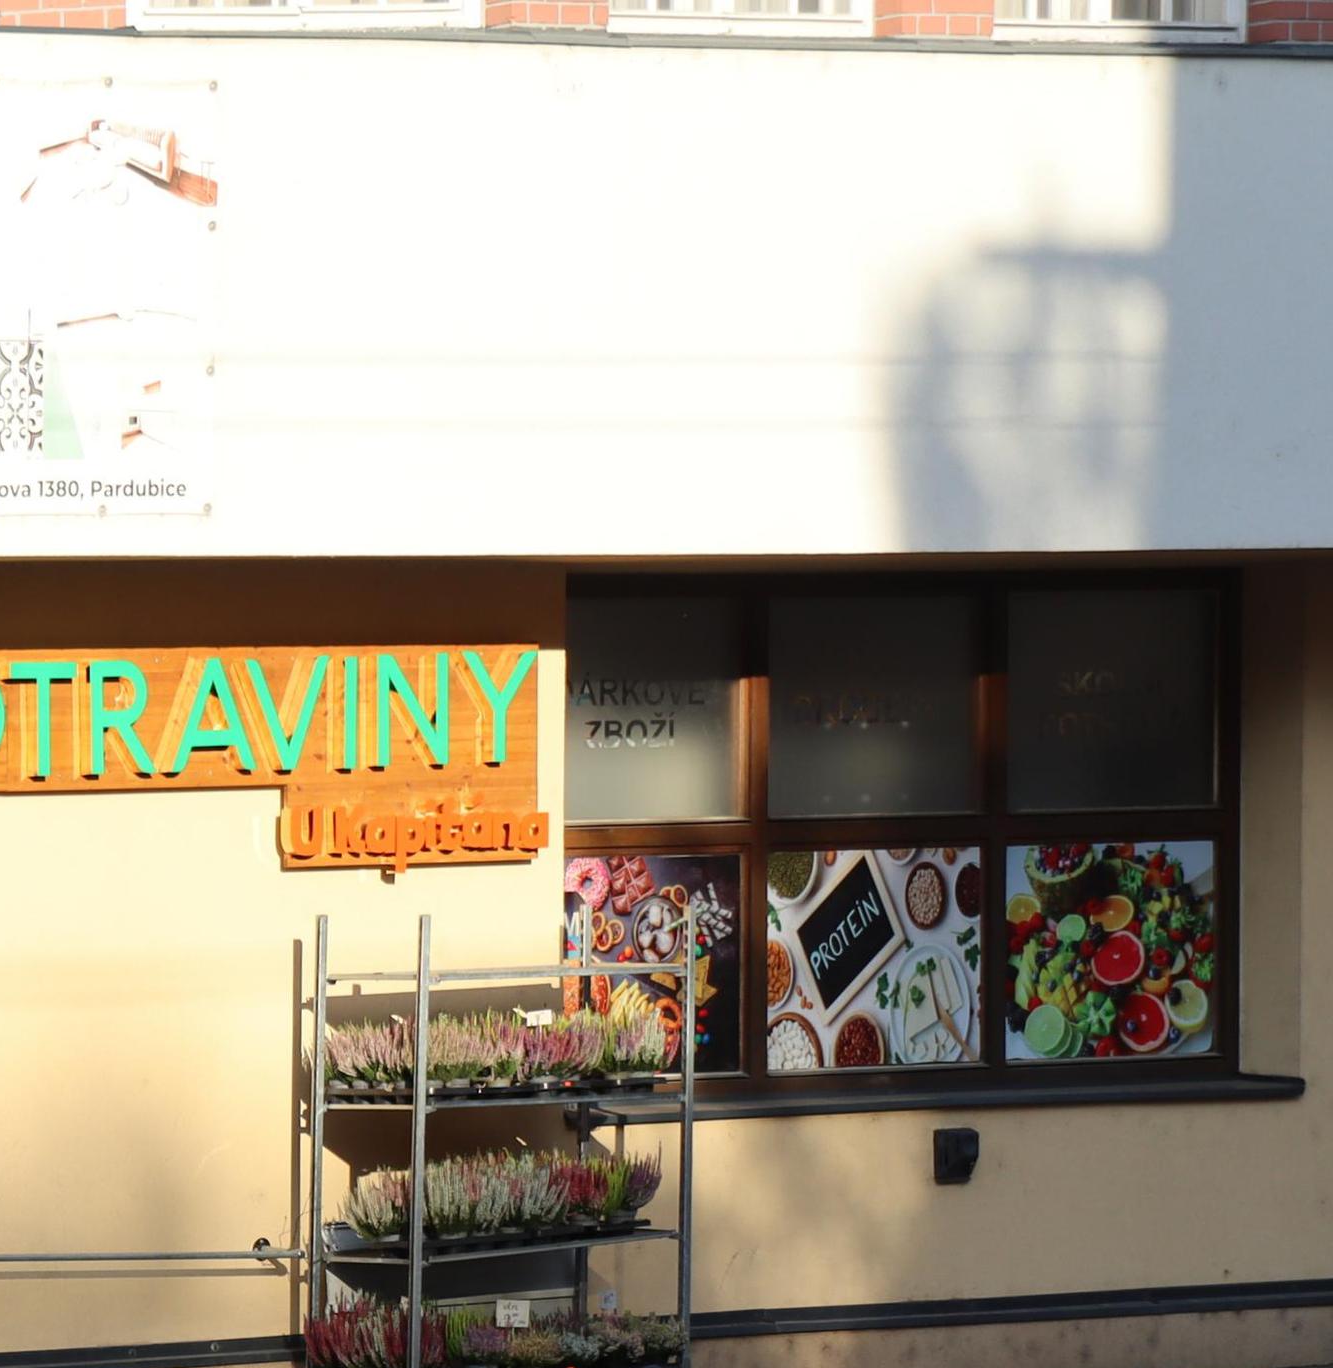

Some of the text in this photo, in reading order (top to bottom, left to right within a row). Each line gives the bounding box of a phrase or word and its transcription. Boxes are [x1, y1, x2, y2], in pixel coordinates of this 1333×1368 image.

[37, 479, 85, 501] 1380,
[90, 479, 187, 499] Pardubice
[584, 711, 676, 748] ZBOŽÍ
